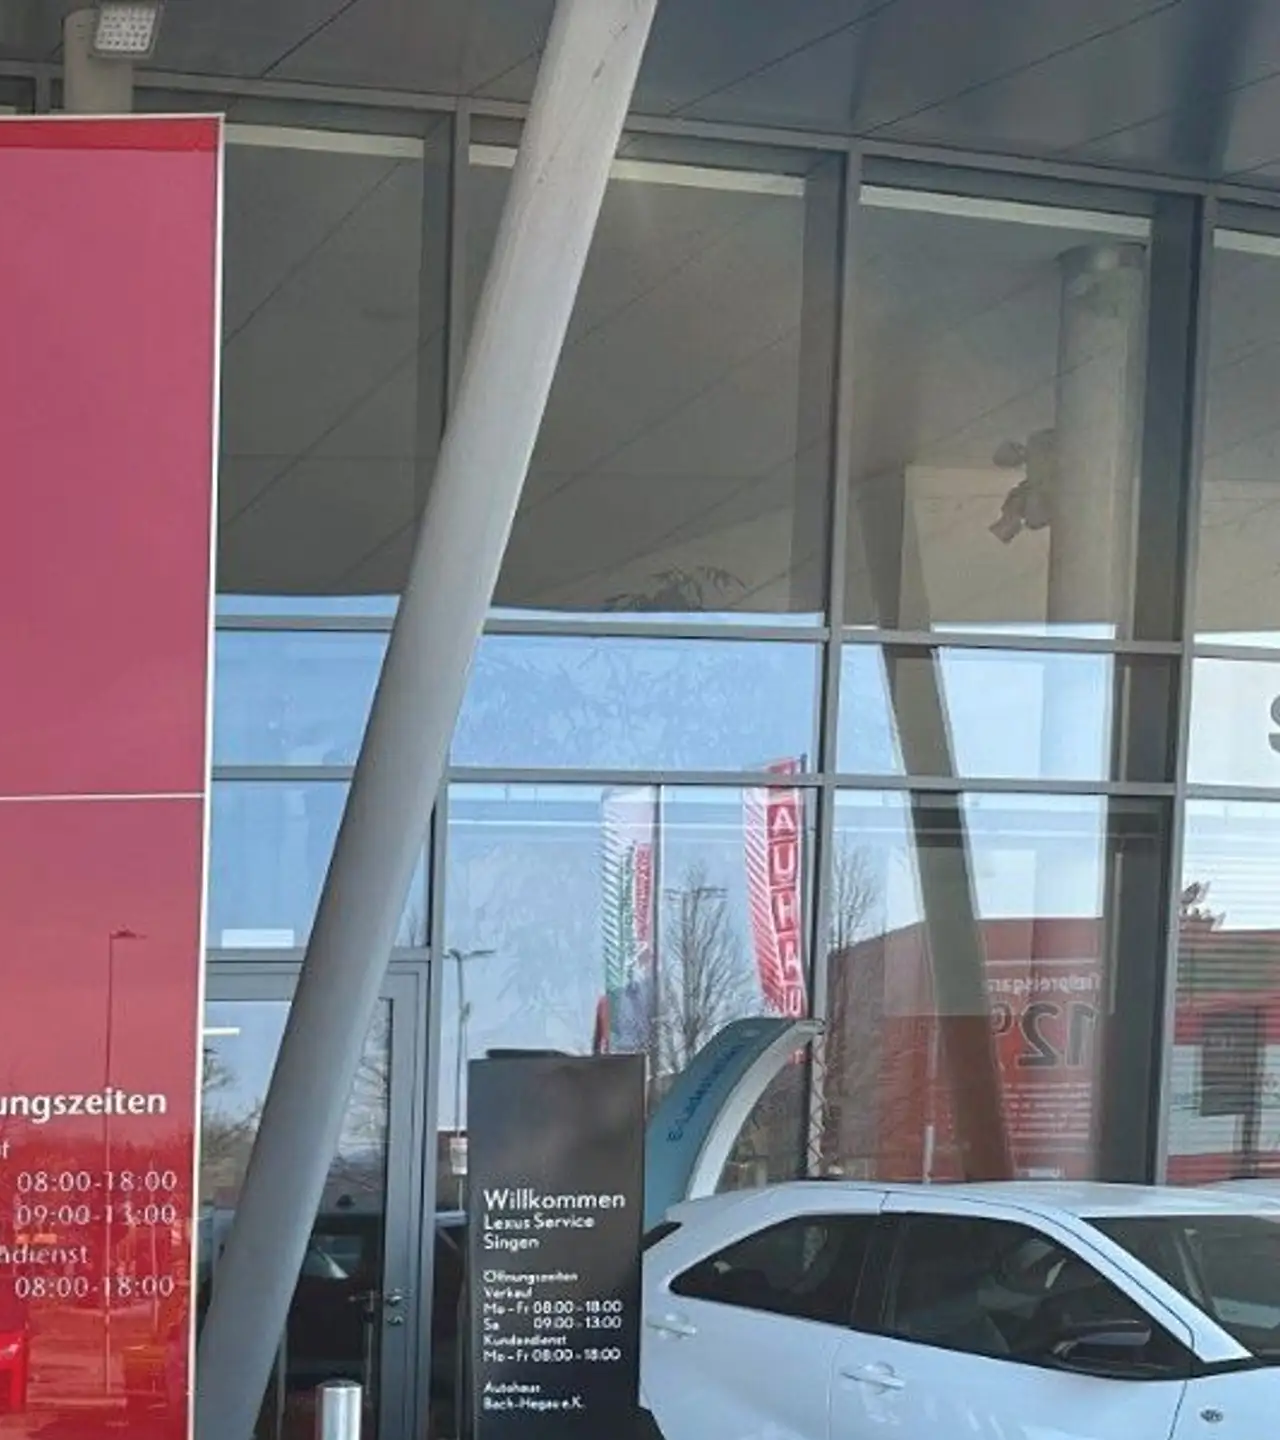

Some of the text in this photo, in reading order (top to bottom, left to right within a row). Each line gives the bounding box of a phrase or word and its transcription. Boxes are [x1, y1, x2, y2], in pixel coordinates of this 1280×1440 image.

[483, 1188, 626, 1210] Willkommen
[483, 1212, 595, 1230] Lexus Service
[483, 1232, 540, 1252] Singen
[483, 1286, 533, 1299] Verkauf
[483, 1318, 500, 1331] Sa
[483, 1335, 567, 1347] Kundendienst
